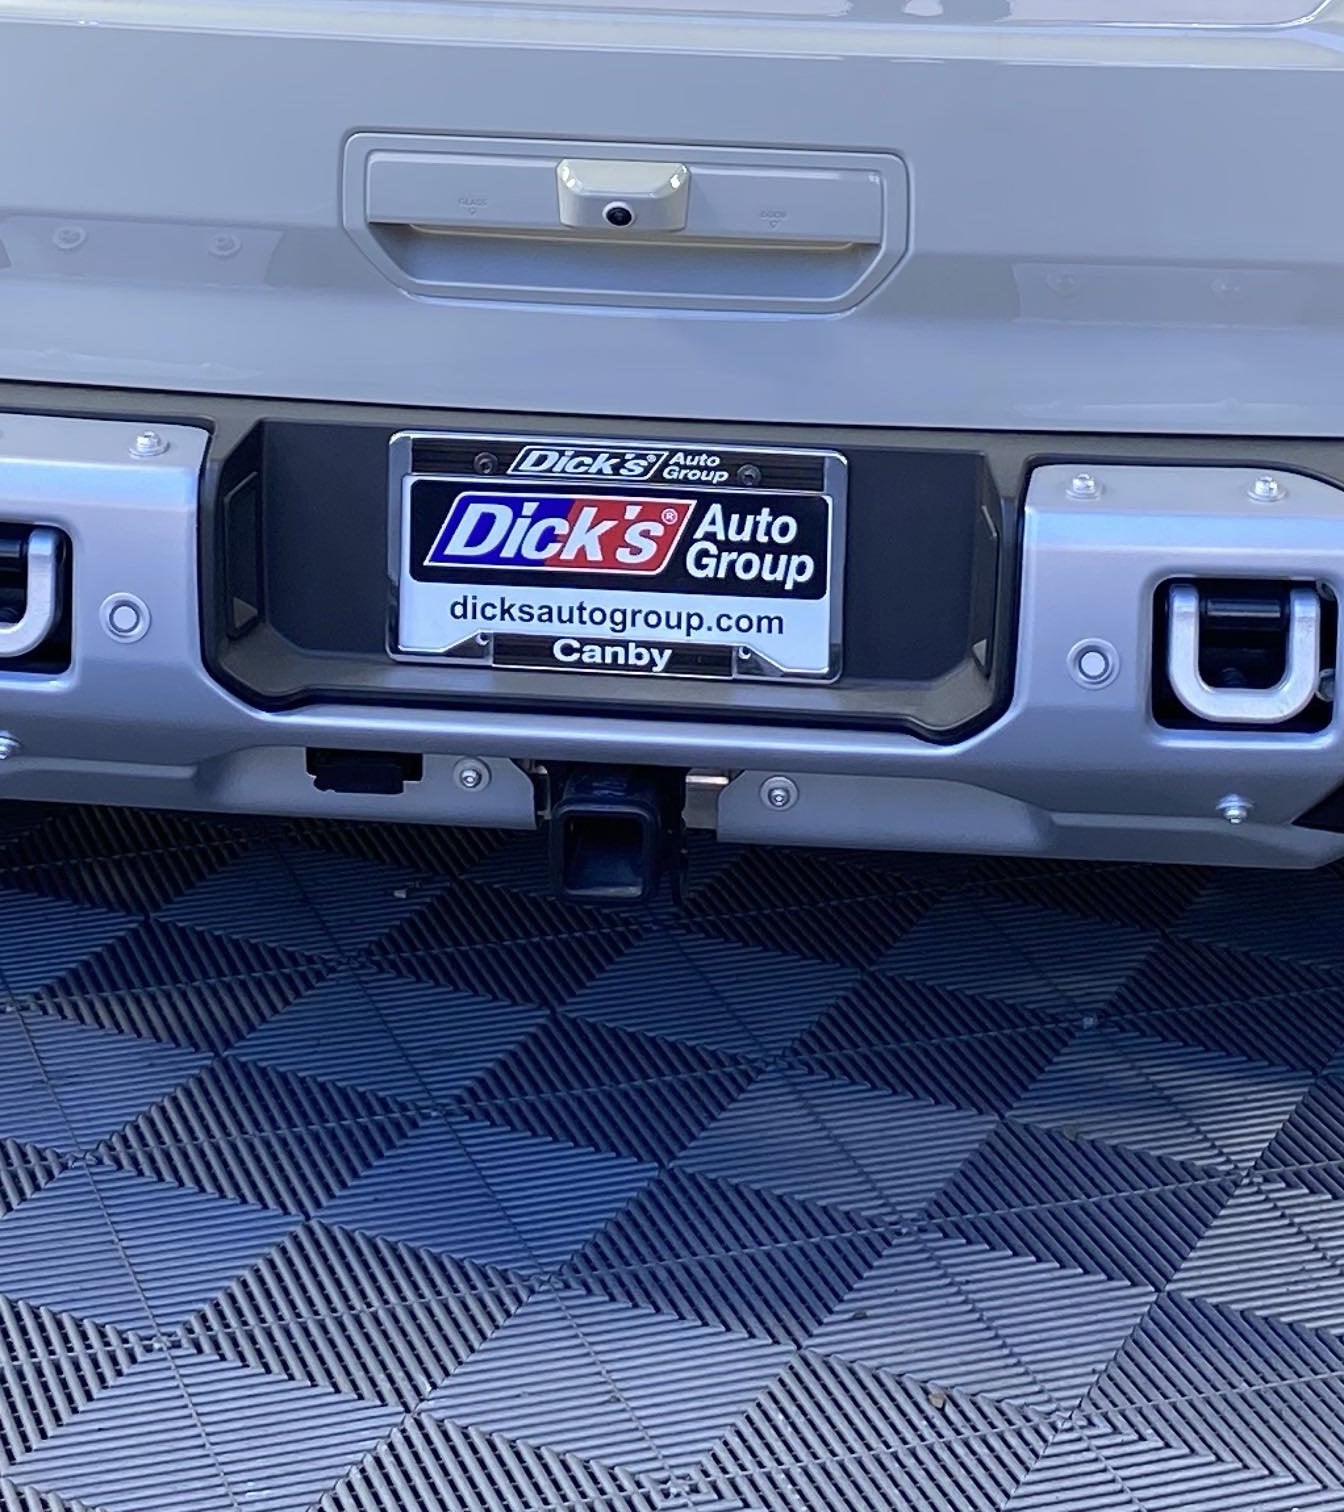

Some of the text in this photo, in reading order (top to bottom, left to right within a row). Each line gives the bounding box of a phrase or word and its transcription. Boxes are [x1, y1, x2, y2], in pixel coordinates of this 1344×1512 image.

[662, 466, 729, 484] Group
[668, 452, 720, 467] Auto
[692, 503, 797, 544] Auto
[686, 542, 815, 589] Group
[450, 596, 784, 637] dicksautogroup.com
[553, 639, 672, 672] Canby
